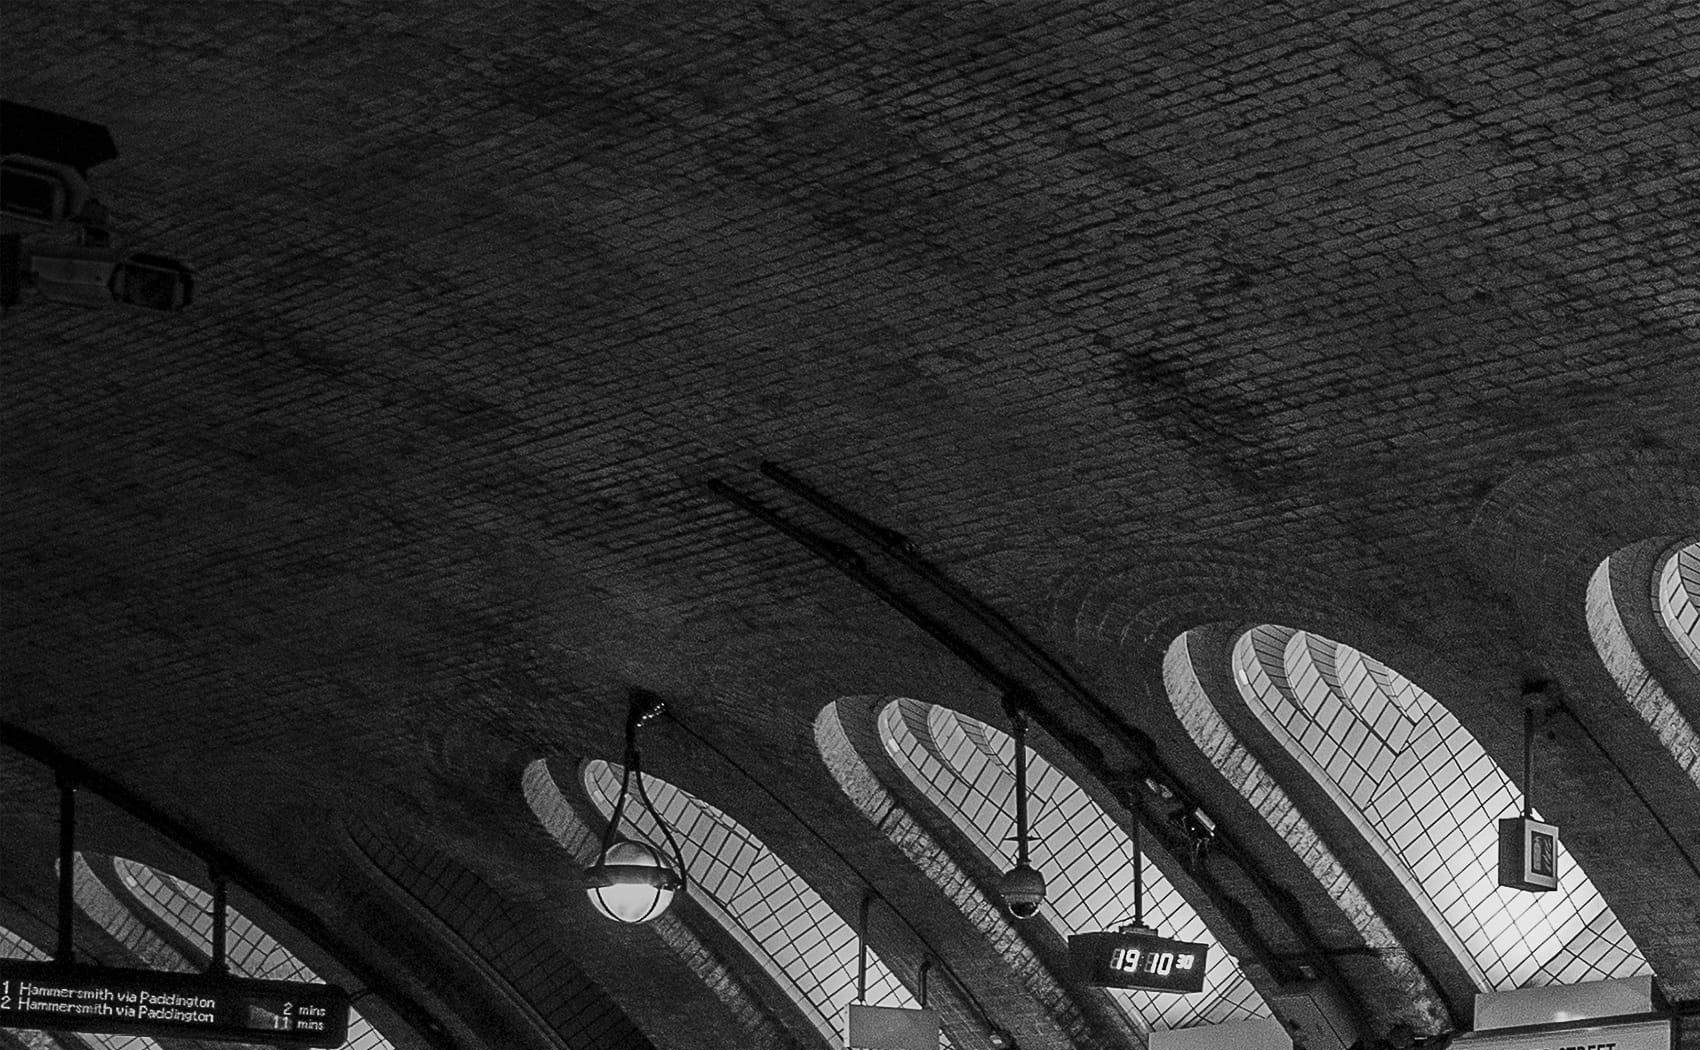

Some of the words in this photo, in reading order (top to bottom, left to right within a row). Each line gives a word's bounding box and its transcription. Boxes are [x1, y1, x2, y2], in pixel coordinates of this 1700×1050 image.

[1114, 949, 1175, 976] 19:10
[1175, 954, 1195, 970] 30
[0, 995, 11, 1010] 2
[18, 996, 113, 1015] Hammersmith
[116, 1005, 136, 1017] via
[138, 1005, 214, 1023] Paddington
[273, 1015, 289, 1029] 11
[297, 1020, 324, 1031] mins
[2, 980, 9, 994] 1
[20, 981, 114, 1001] Hammersmith
[117, 991, 137, 1003] via
[139, 991, 215, 1009] Paddington
[283, 1002, 293, 1016] 2
[298, 1005, 326, 1017] mins
